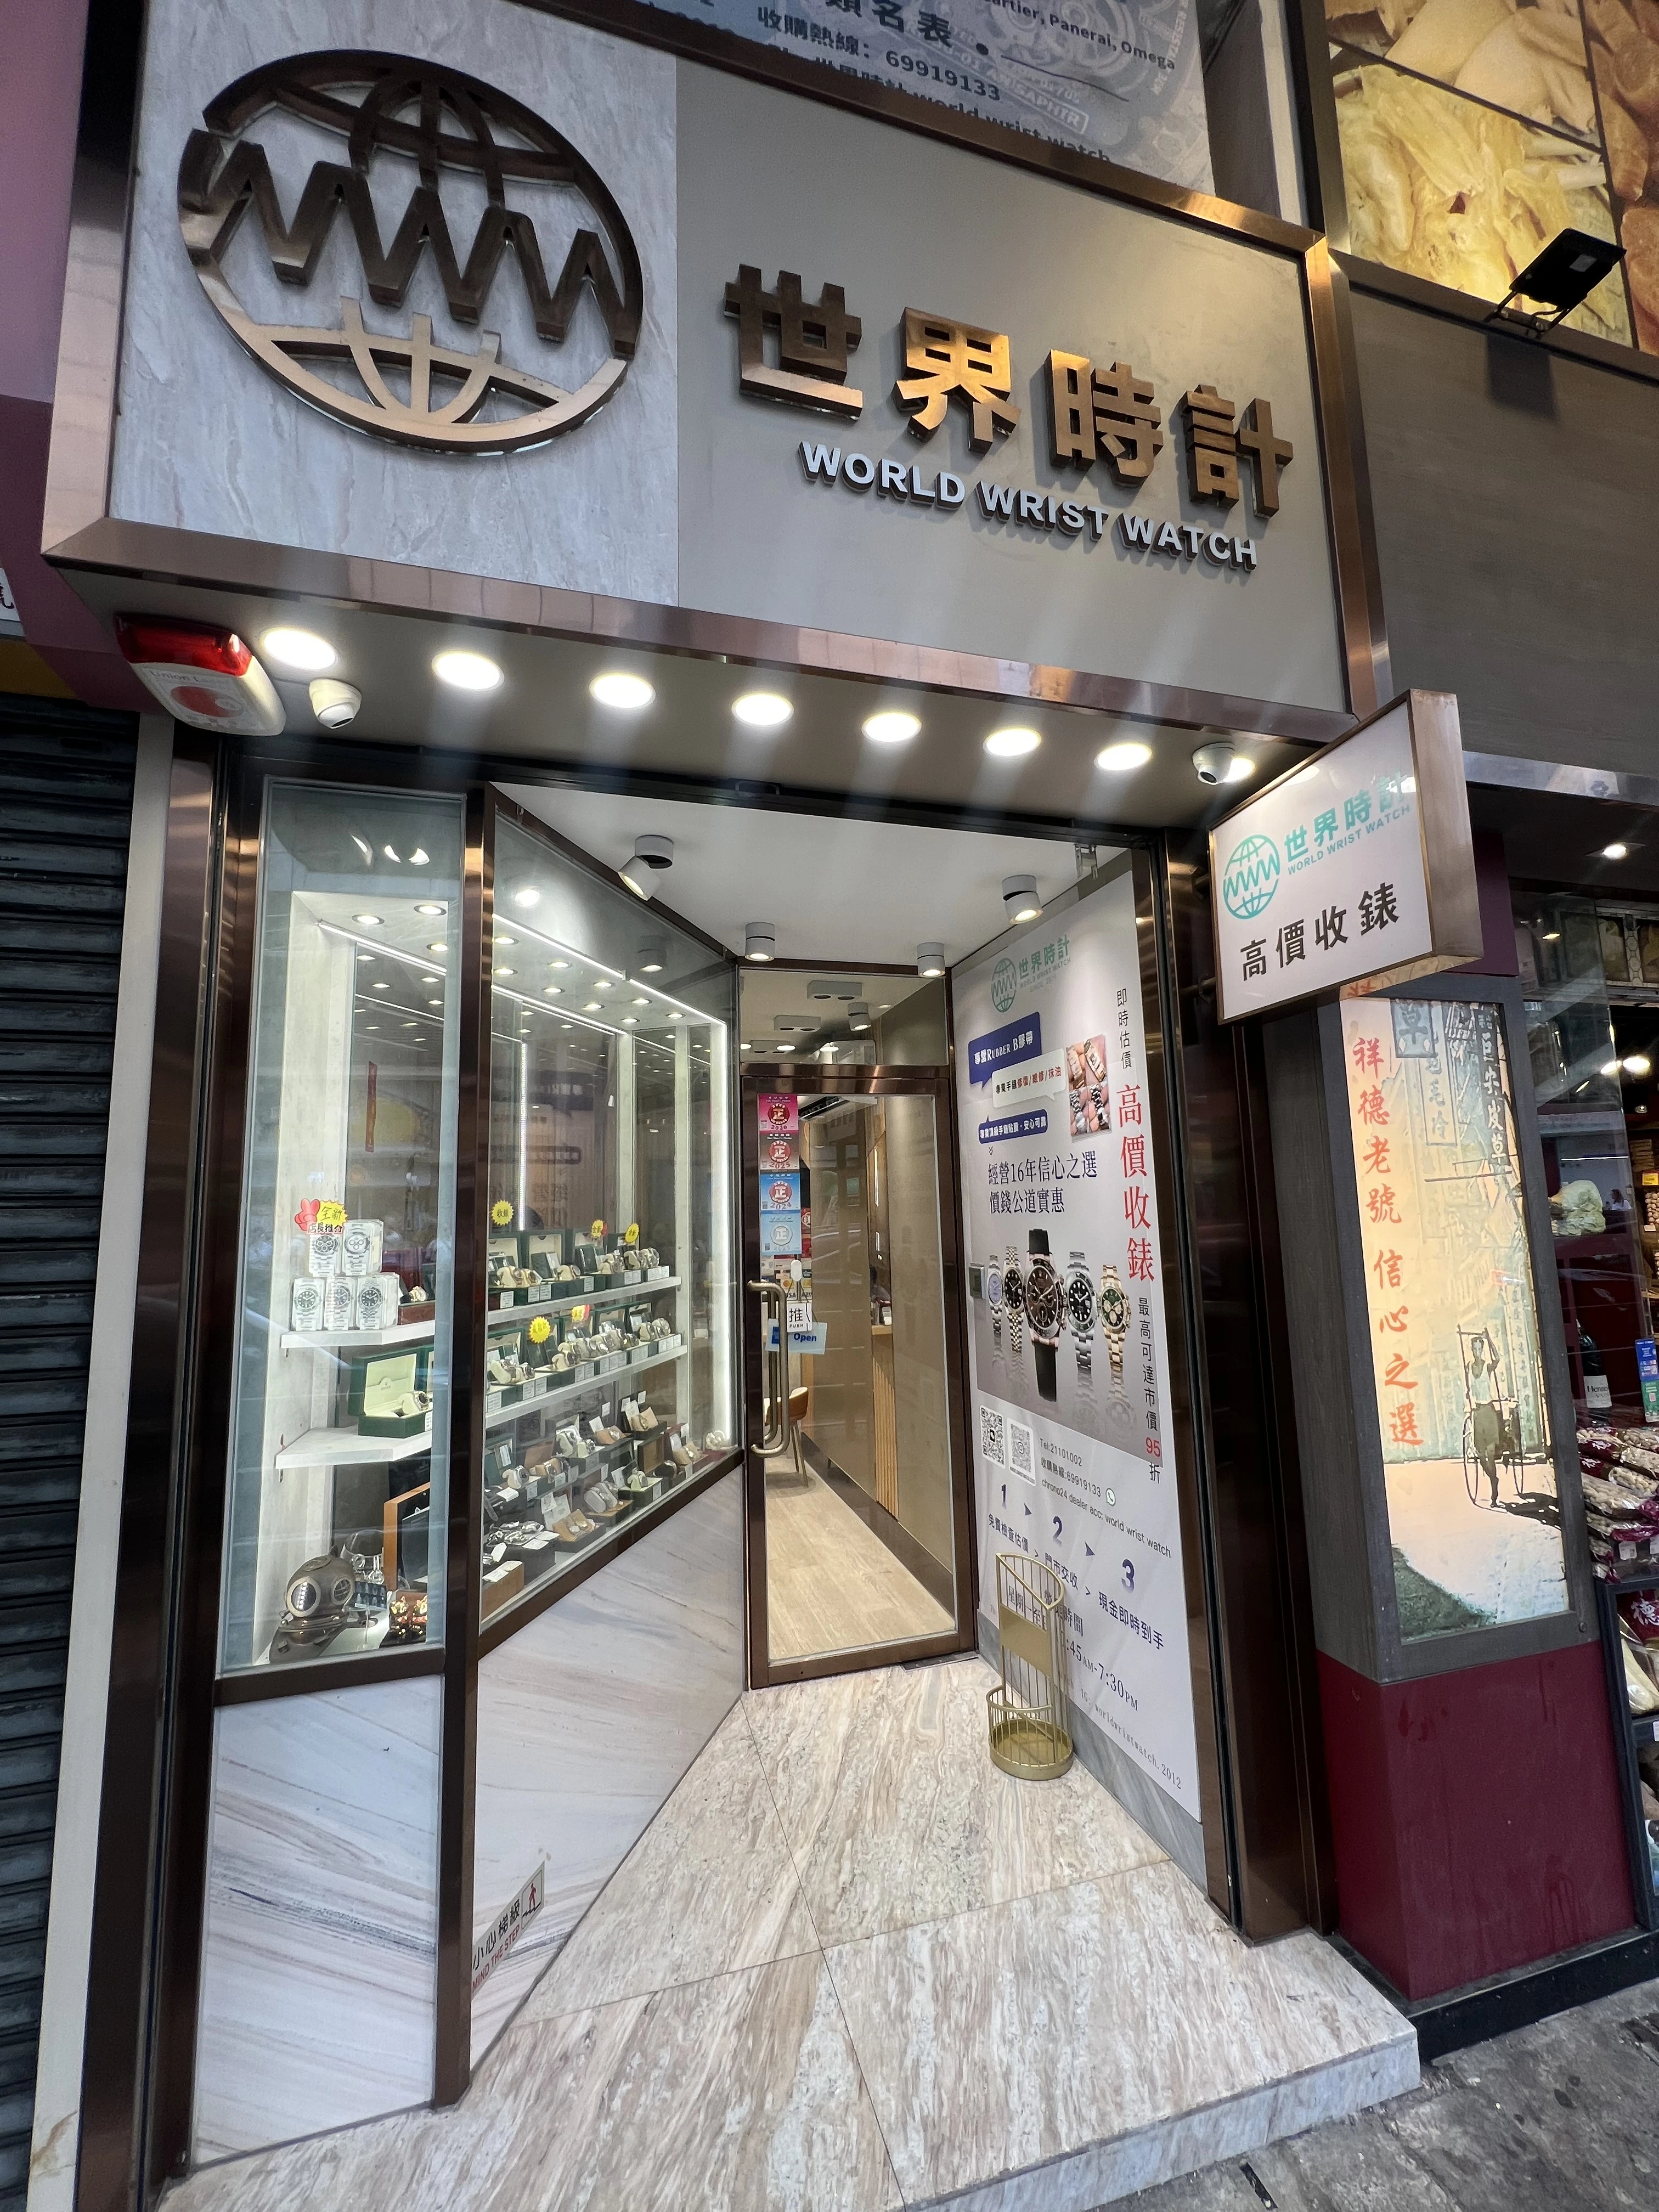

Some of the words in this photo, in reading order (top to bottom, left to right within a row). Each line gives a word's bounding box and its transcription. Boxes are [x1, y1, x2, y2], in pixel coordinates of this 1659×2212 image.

[985, 0, 1045, 25] artier,
[1121, 41, 1175, 70] Omega
[886, 50, 1001, 101] 69919133
[724, 263, 1294, 518] 世界時計
[798, 440, 966, 512] WORLD
[975, 479, 1109, 542] WRIST
[1116, 512, 1258, 573] WATCH
[1284, 769, 1407, 862] 世界時計
[1288, 850, 1323, 876] WORLD
[1327, 828, 1362, 854] WRIST
[1365, 803, 1410, 834] WATCH
[1018, 934, 1070, 980] 世界時計
[1240, 881, 1400, 981] 高價收錶
[1052, 956, 1071, 972] WATCH
[1116, 988, 1132, 1070] 即時估價
[988, 1150, 1098, 1185] 經營16年信心之選
[1115, 1083, 1155, 1282] 高價收錶
[321, 1206, 343, 1221] 全新
[990, 1187, 1065, 1214] 價錢公道實惠
[789, 1307, 803, 1322] 推
[793, 1332, 817, 1343] Open
[1001, 1484, 1007, 1509] 1
[1069, 1493, 1088, 1512] dealer
[1105, 1515, 1125, 1532] world
[1126, 1526, 1145, 1543] wrist
[1146, 1538, 1172, 1559] watch
[1053, 1516, 1063, 1547] 2
[1121, 1559, 1136, 1593] 3
[1098, 1591, 1164, 1650] 現金即時到手
[1094, 1703, 1182, 1790] worldwristwatch.2012
[471, 1962, 490, 1994] MIND
[490, 1944, 504, 1968] THE
[504, 1923, 520, 1952] STEP
